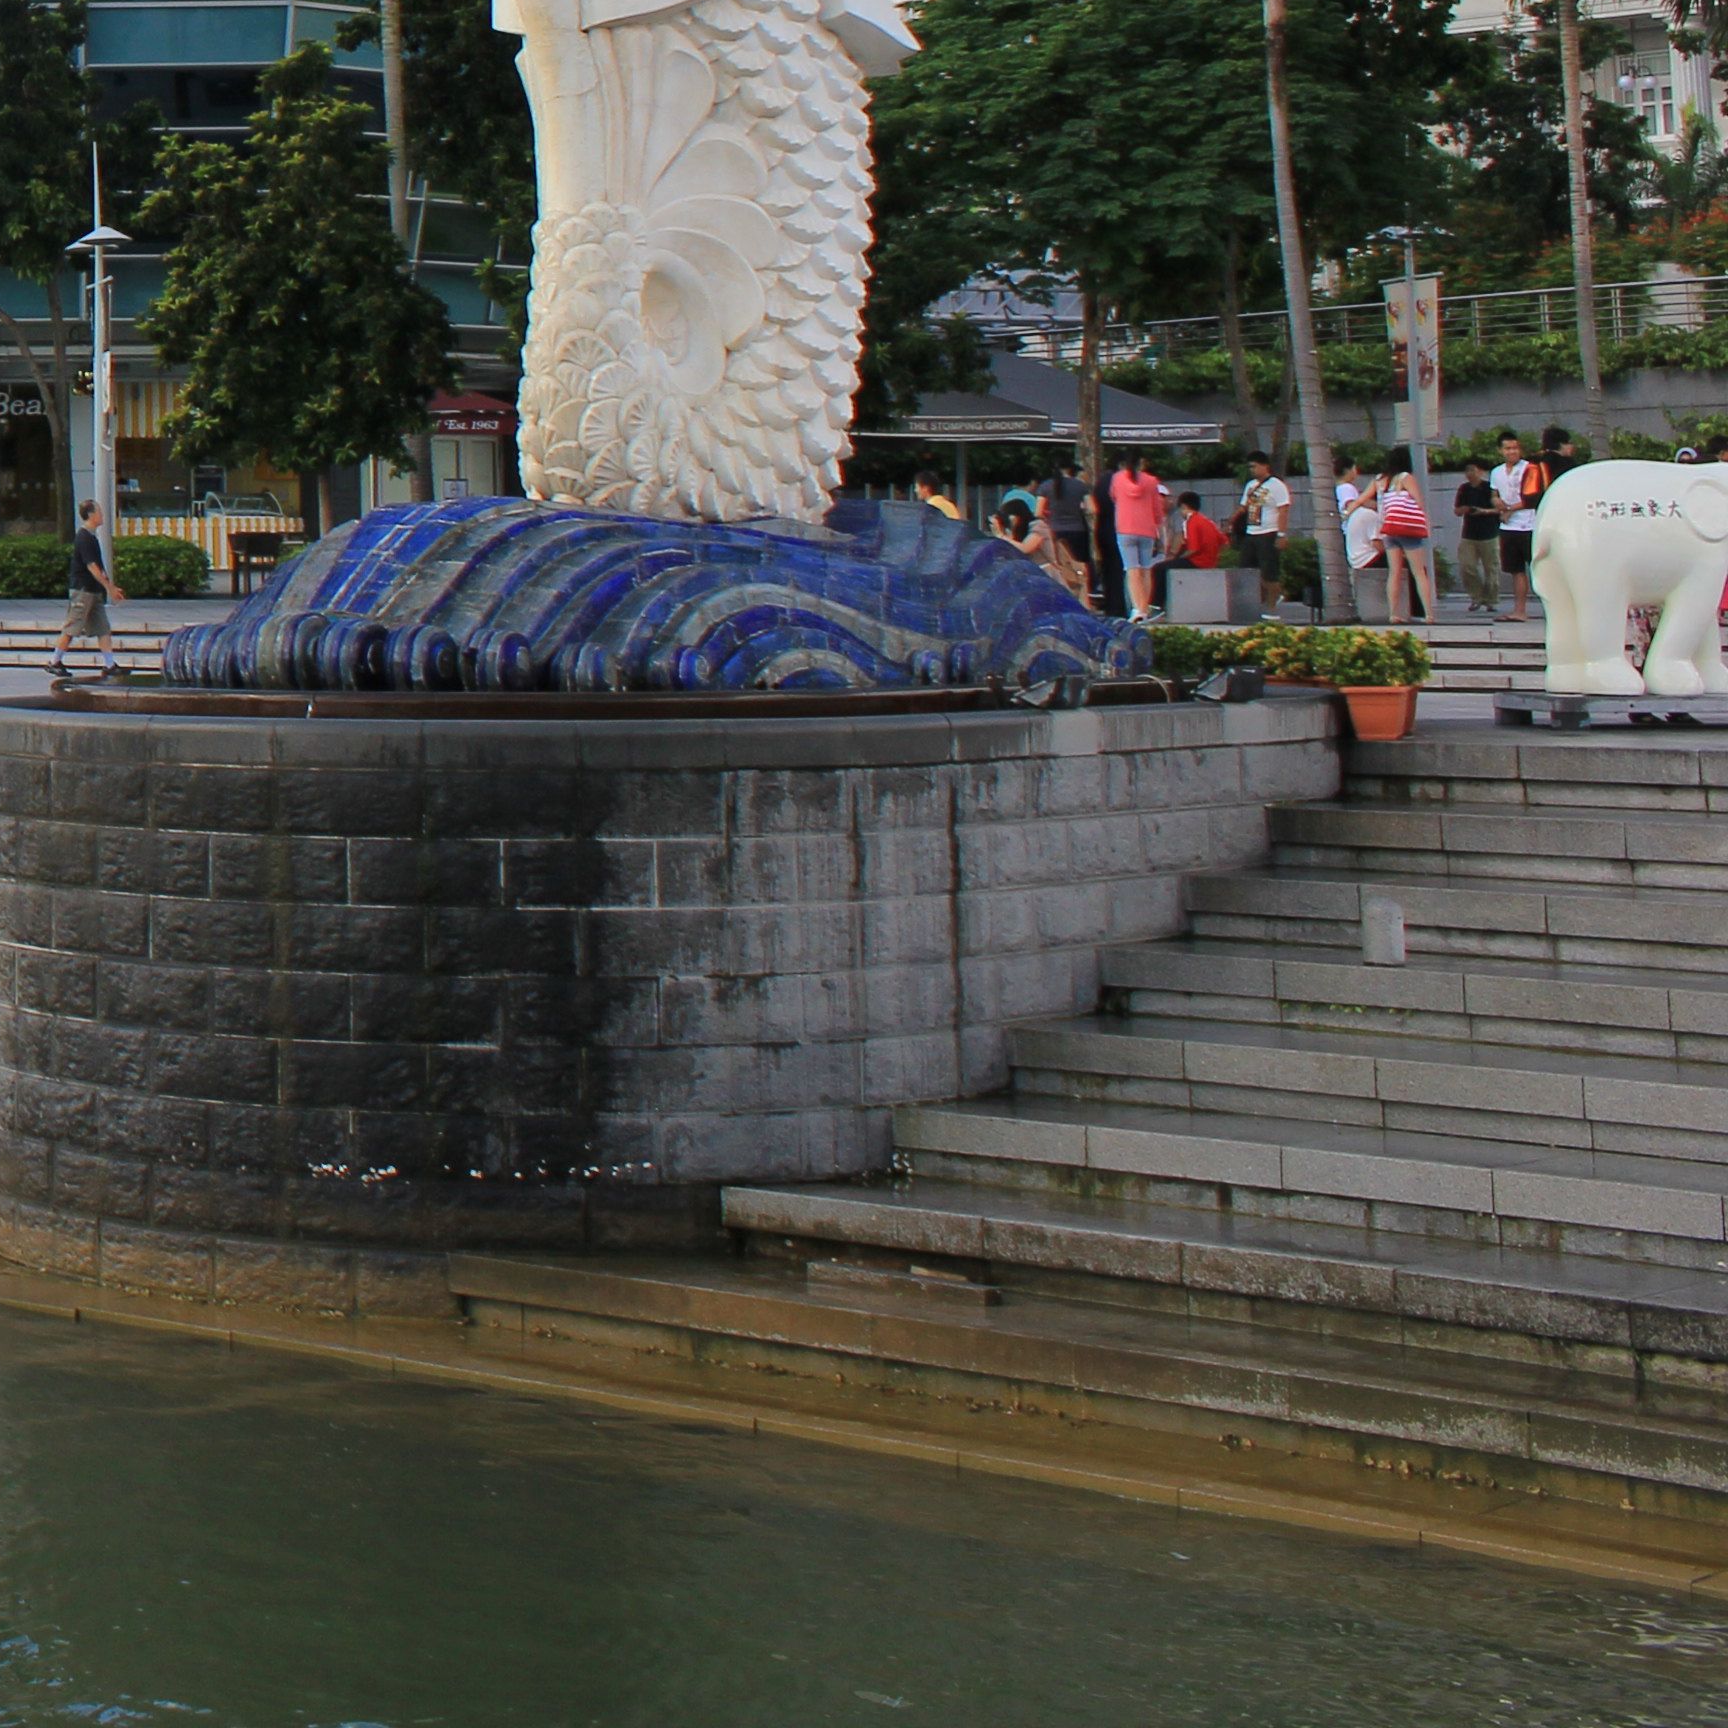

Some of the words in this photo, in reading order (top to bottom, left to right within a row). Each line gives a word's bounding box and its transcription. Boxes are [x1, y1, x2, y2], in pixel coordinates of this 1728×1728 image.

[471, 419, 499, 430] 1963
[908, 421, 928, 431] THE
[930, 421, 982, 432] STOMPING
[984, 420, 1029, 431] GROUND
[1111, 428, 1158, 438] STOMPING
